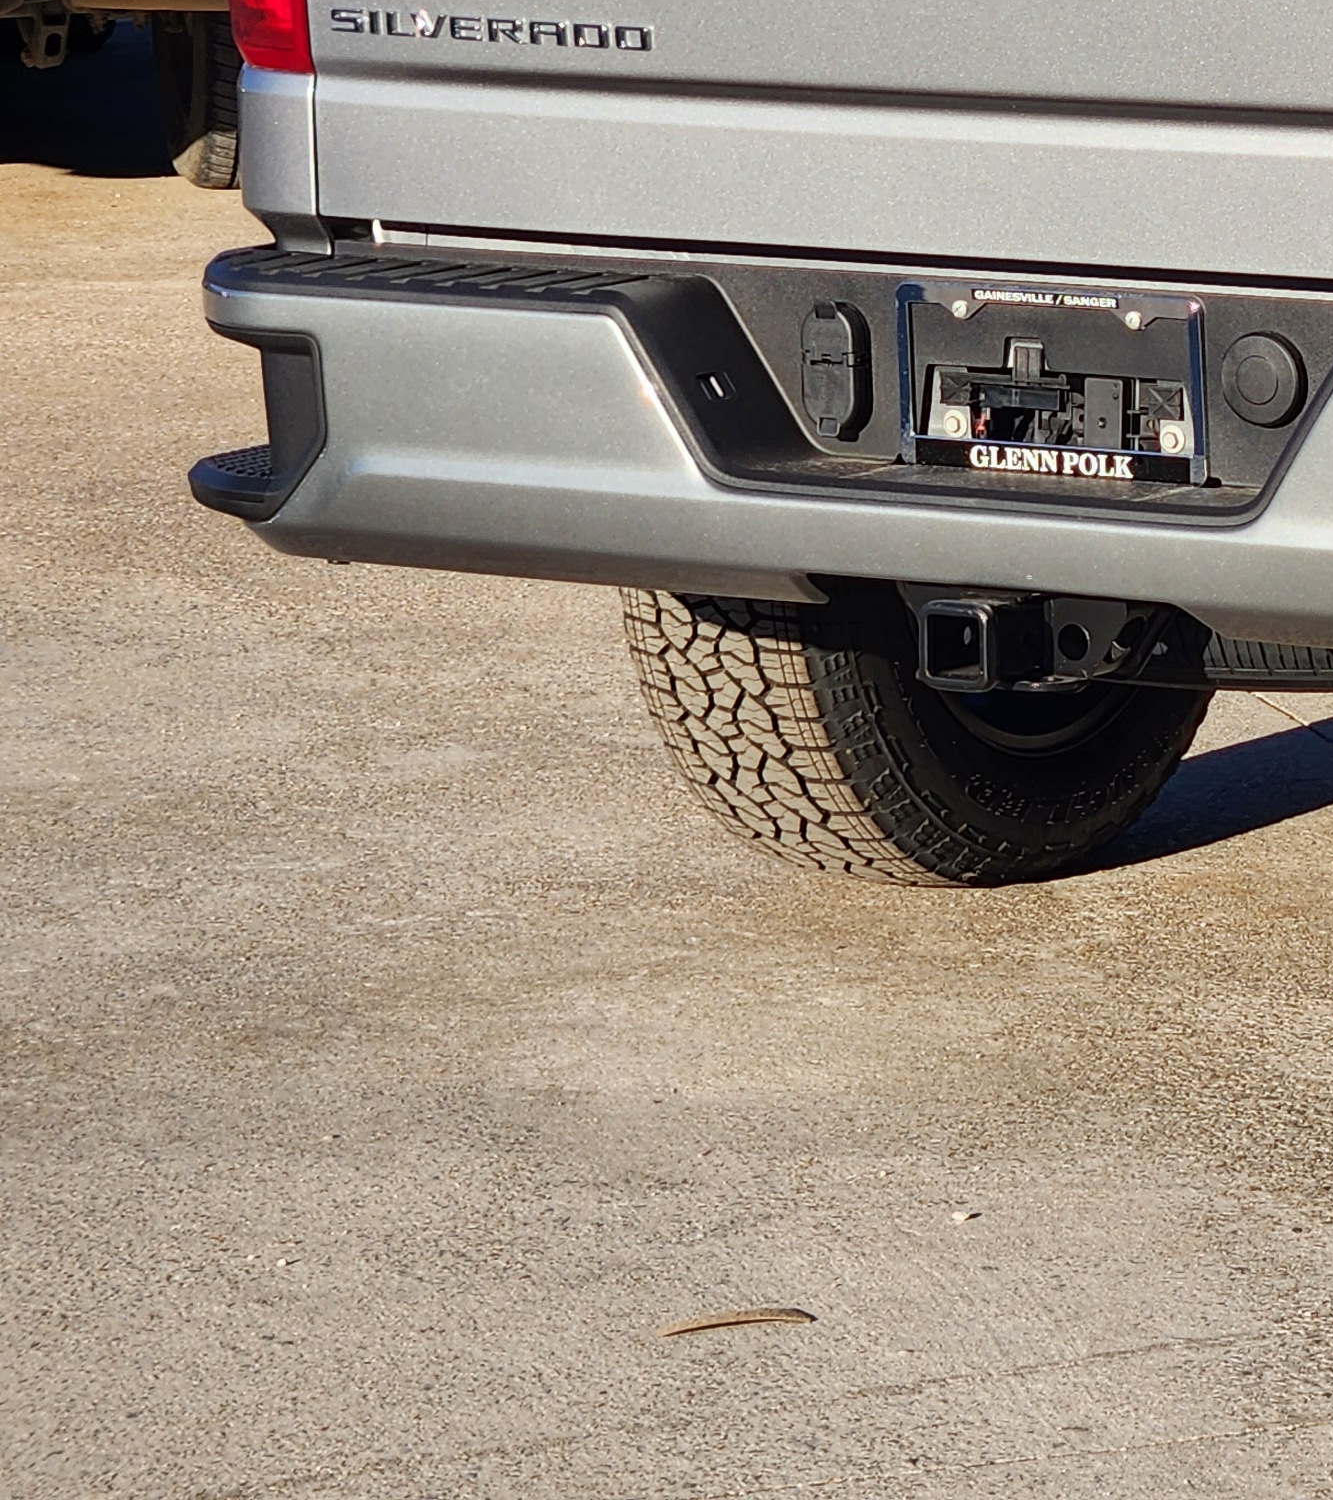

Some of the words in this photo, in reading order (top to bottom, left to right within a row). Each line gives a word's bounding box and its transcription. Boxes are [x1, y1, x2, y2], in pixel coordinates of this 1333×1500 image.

[330, 7, 655, 51] SILVERADO
[974, 290, 1054, 304] GAINESVILLE
[1063, 295, 1117, 308] SANGER
[970, 445, 1058, 473] GLENN
[1062, 452, 1134, 479] POLK
